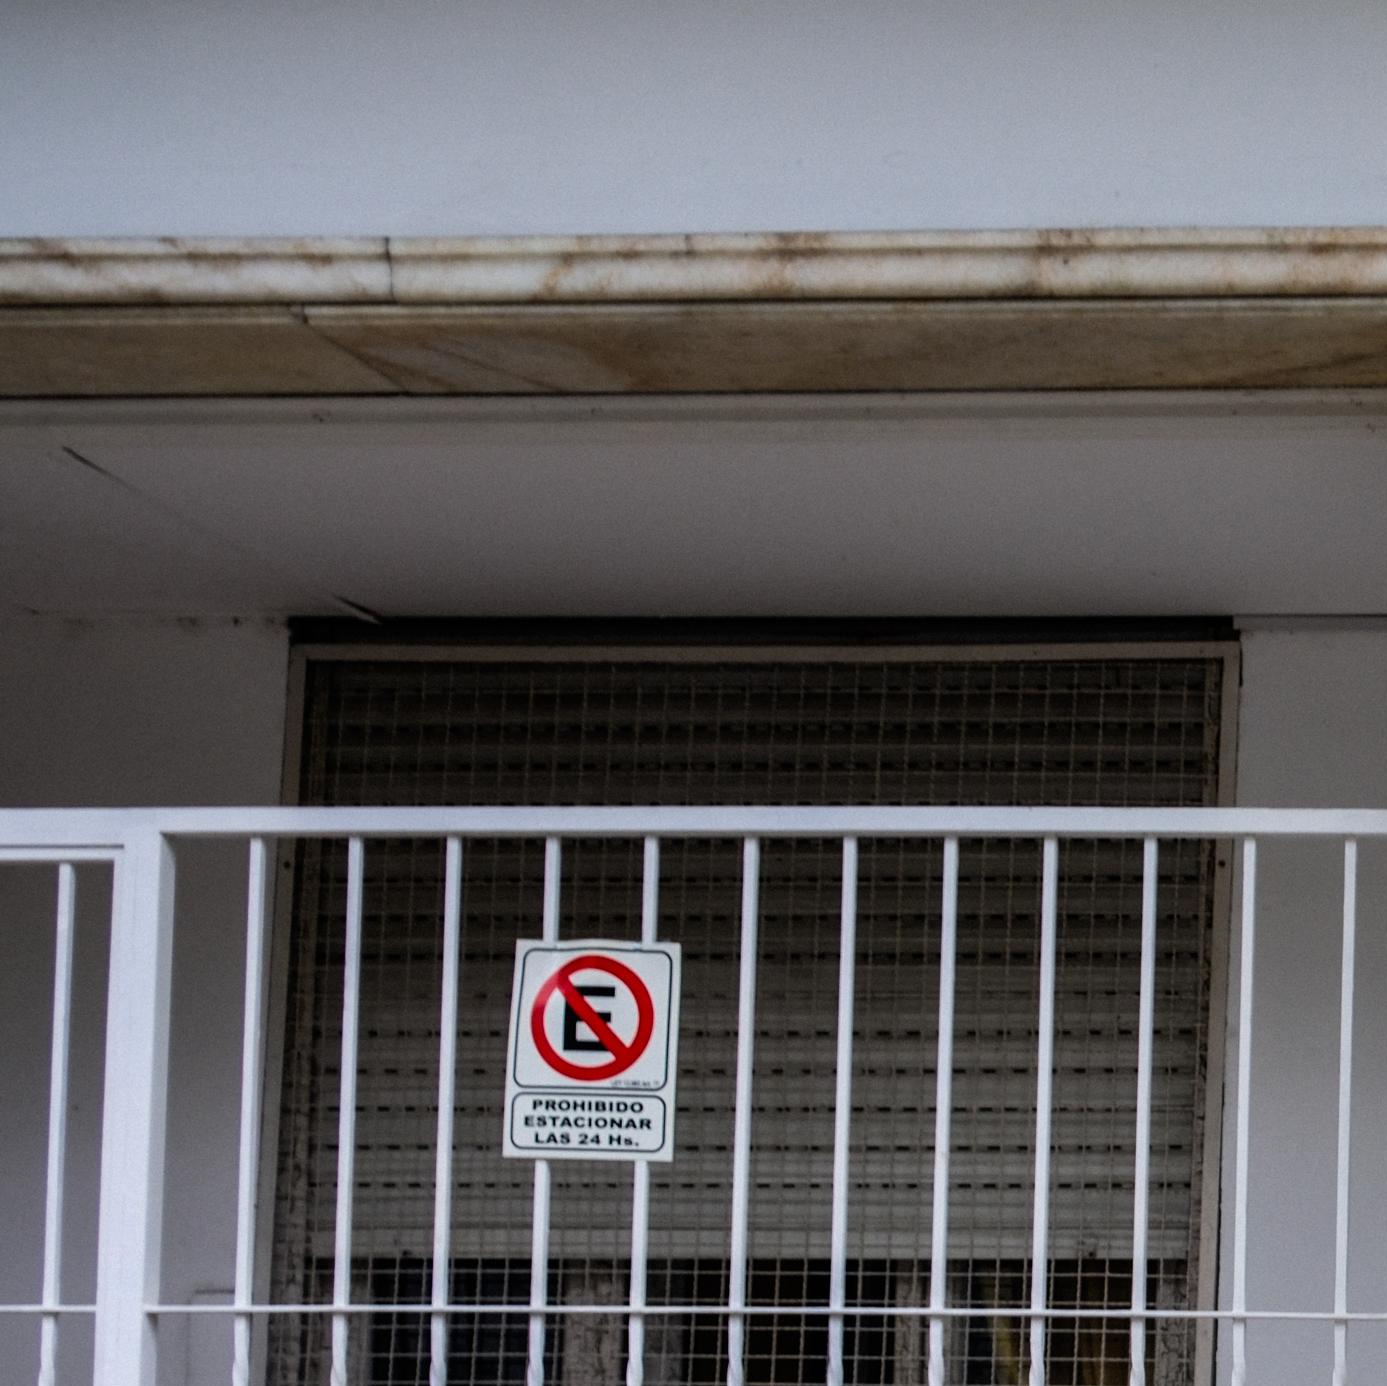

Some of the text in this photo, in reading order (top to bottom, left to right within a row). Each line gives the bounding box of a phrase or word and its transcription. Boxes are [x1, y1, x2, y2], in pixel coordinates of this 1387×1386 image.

[562, 985, 616, 1052] E
[531, 1098, 645, 1113] PROHIBIDO
[523, 1115, 653, 1131] ESTACIONAR
[533, 1132, 641, 1148] LAS 24 Hs.
